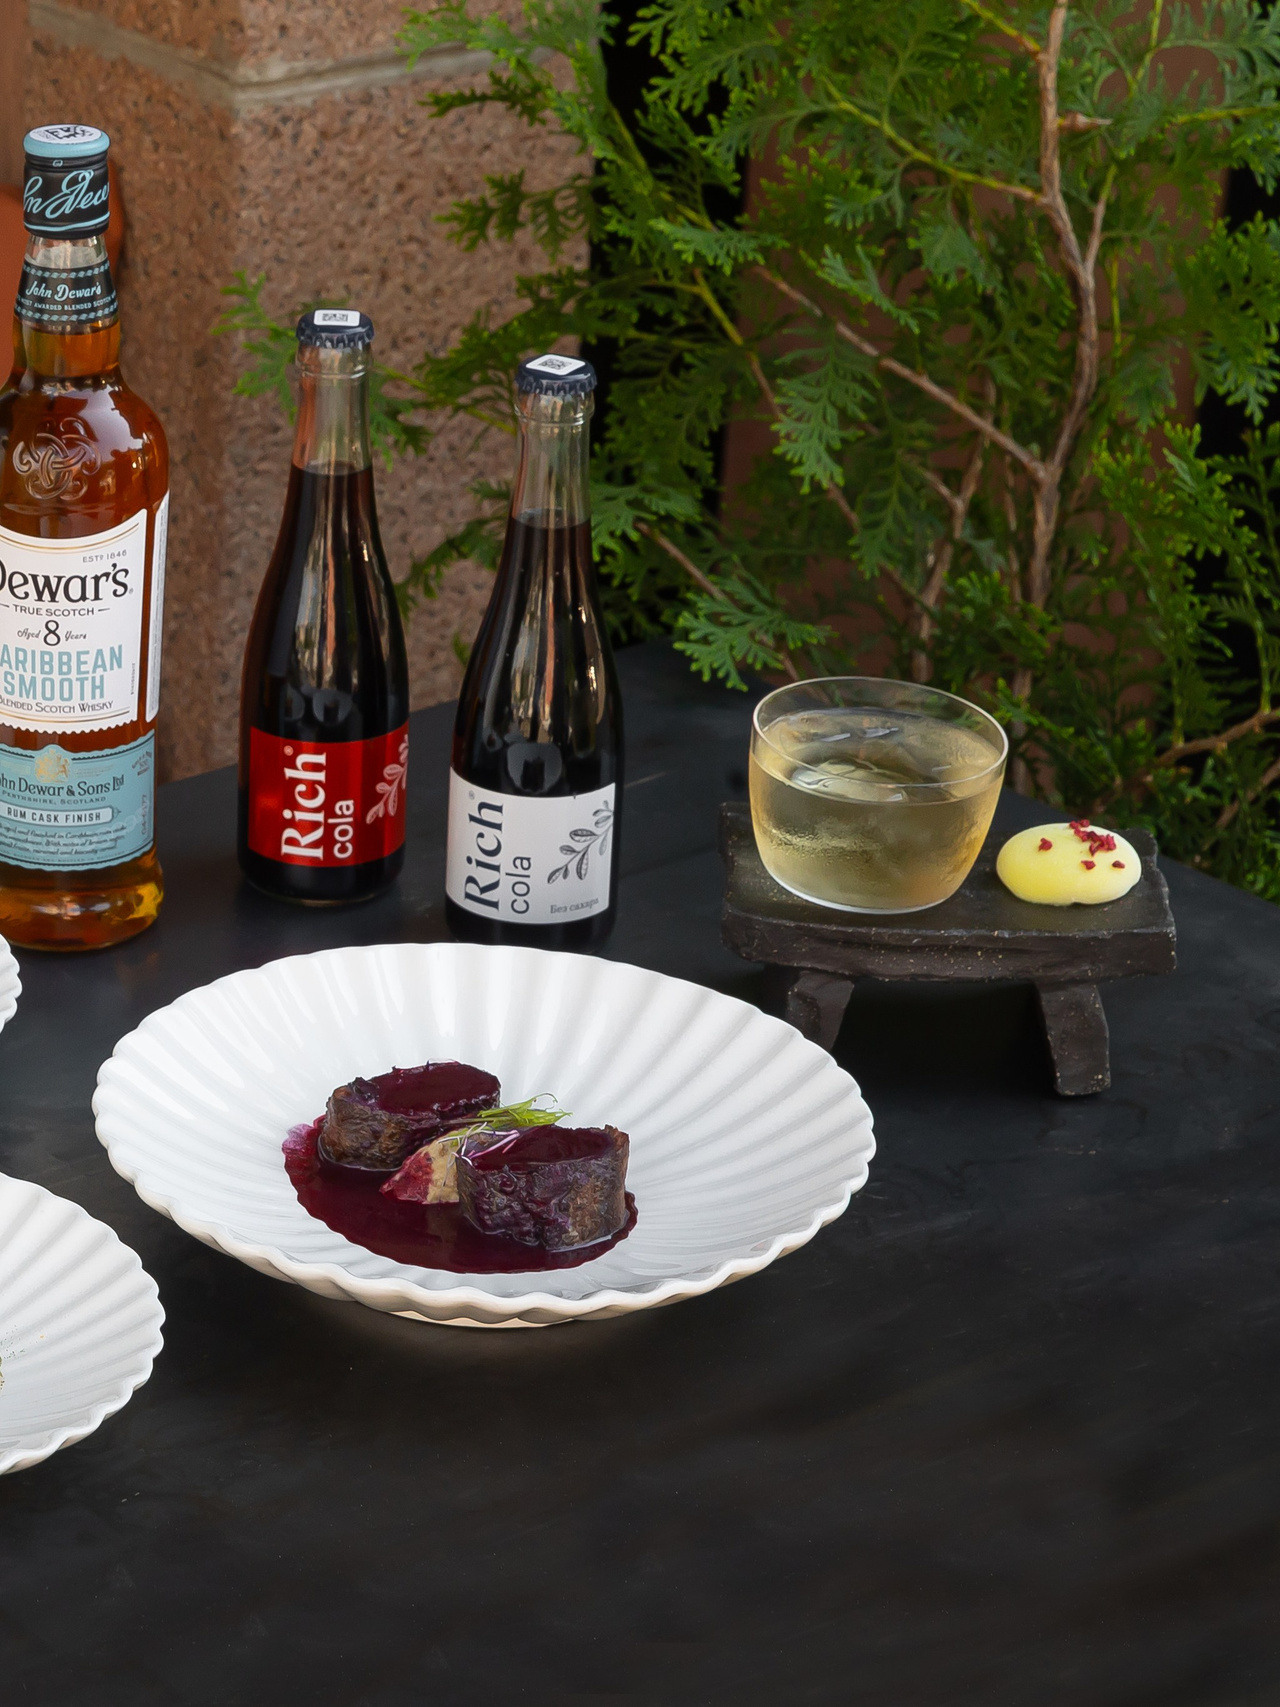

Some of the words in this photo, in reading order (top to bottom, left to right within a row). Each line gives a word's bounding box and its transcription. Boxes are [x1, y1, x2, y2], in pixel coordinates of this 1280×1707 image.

[25, 281, 52, 298] John
[54, 281, 102, 301] Dewar's
[34, 302, 62, 311] AWARDED
[64, 303, 91, 311] BLENDED
[106, 549, 127, 560] 1846
[12, 604, 43, 616] TRUE
[45, 607, 95, 617] SCOTCH
[17, 627, 42, 640] Aged
[43, 620, 61, 647] 8
[64, 631, 87, 641] Years
[3, 670, 105, 702] SMOOTH
[18, 777, 64, 797] Dewar
[66, 785, 76, 797] &
[77, 780, 111, 796] Sons
[7, 806, 27, 820] RUM
[31, 812, 60, 823] CASK
[65, 812, 101, 823] FINISH
[281, 752, 326, 861] Rich
[327, 799, 354, 859] cola
[464, 801, 504, 911] Rich
[505, 856, 532, 914] cola
[551, 905, 567, 914] Без
